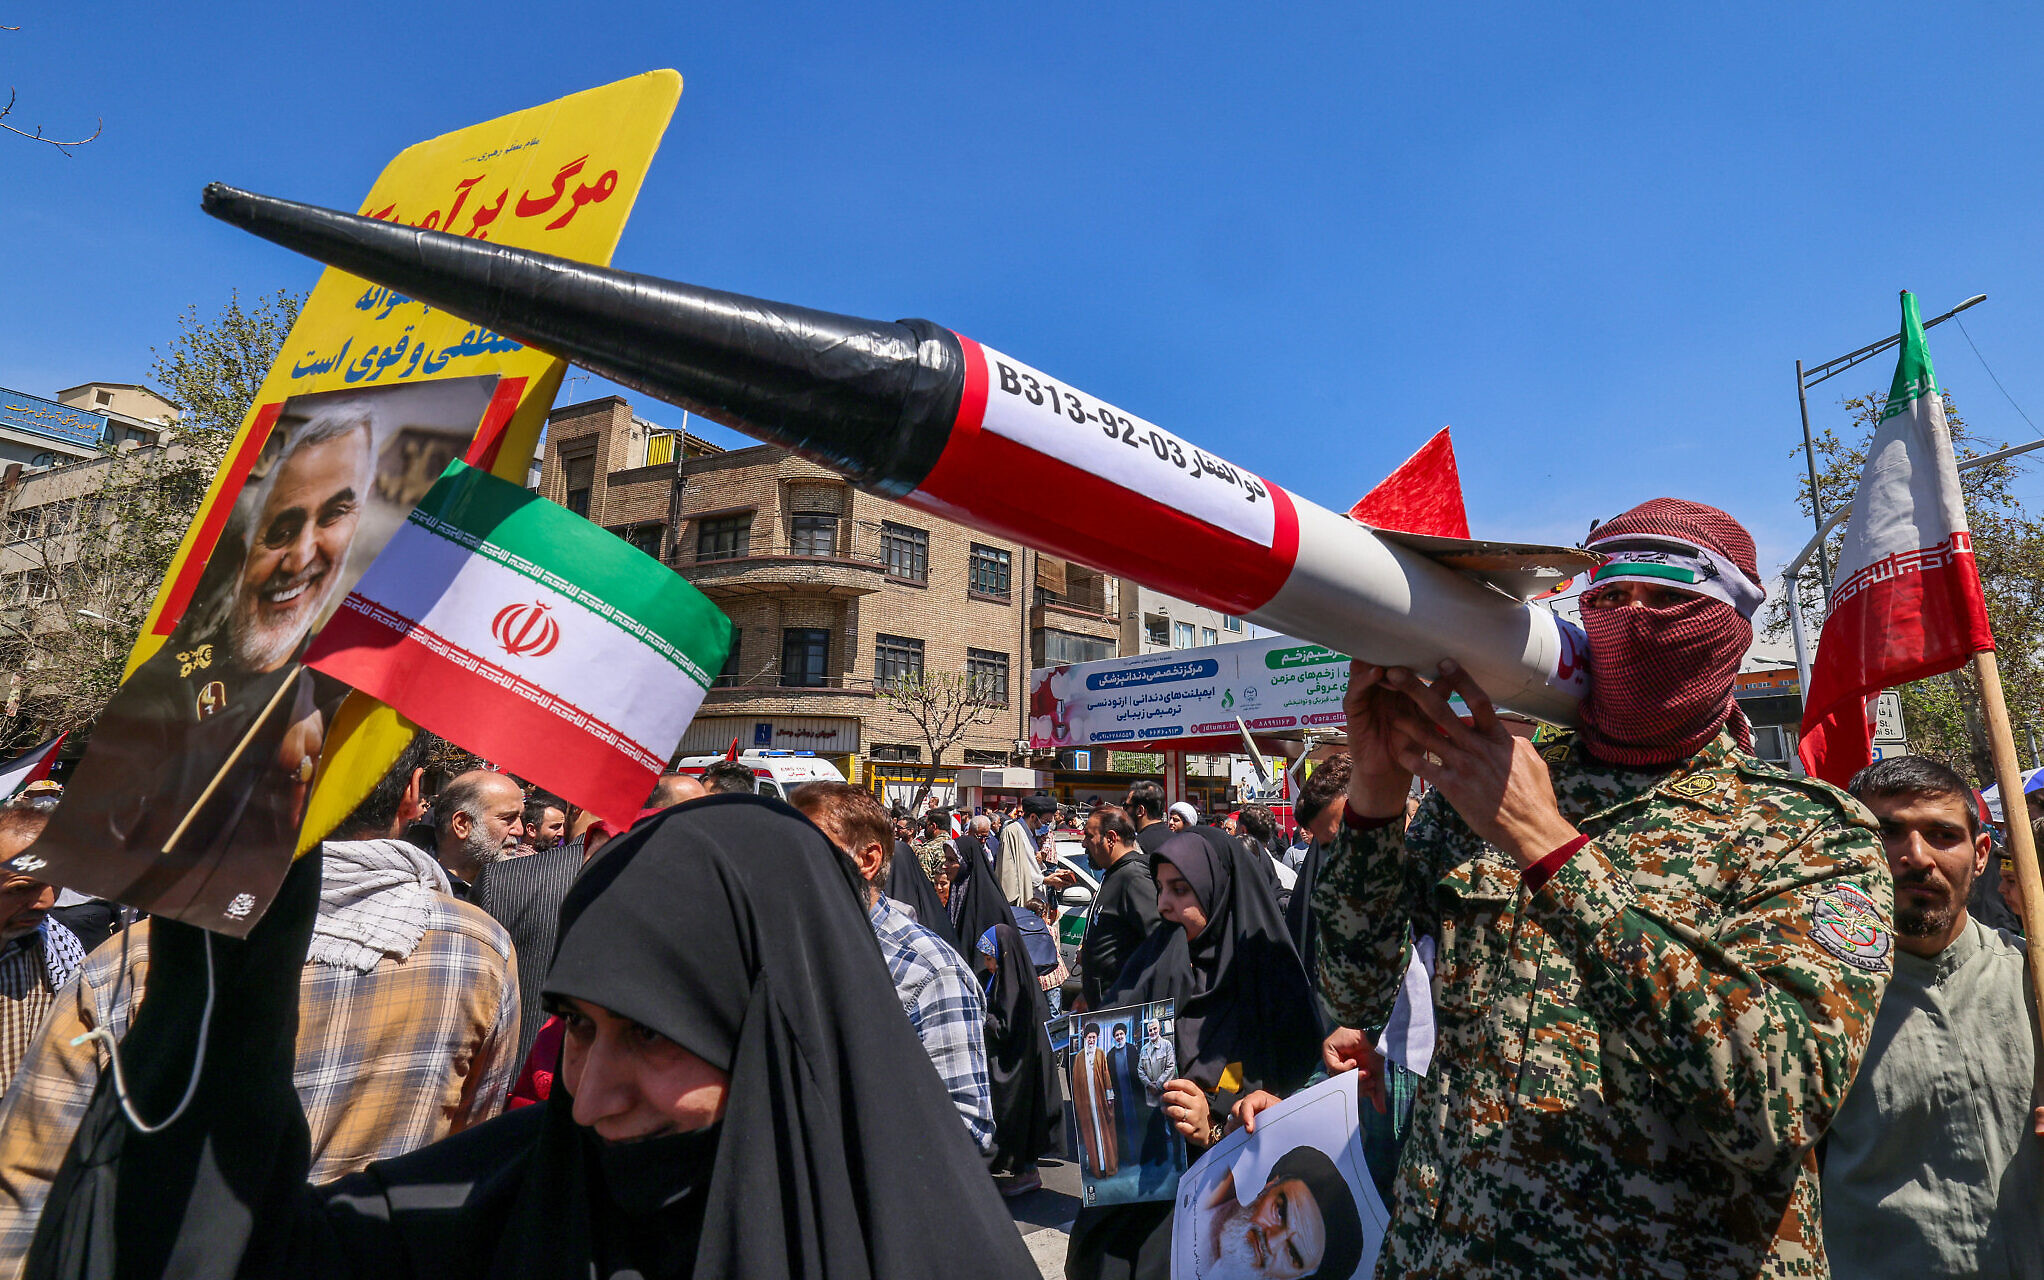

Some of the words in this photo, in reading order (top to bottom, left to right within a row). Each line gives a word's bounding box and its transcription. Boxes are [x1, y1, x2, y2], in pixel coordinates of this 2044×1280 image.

[515, 153, 619, 231] مرگ
[291, 335, 354, 380] است
[344, 325, 415, 384] قوی
[996, 360, 1187, 469] B313-92-03
[1281, 652, 1306, 666] زخم
[1146, 668, 1183, 680] تخصصی
[1182, 664, 1203, 678] مرکز
[1098, 671, 1147, 687] دندانپزشکی
[1270, 674, 1296, 686] مزمن
[1306, 682, 1338, 696] عروقی
[1087, 695, 1128, 711] ارتودنسی
[1132, 693, 1163, 706] دندانی
[1116, 708, 1147, 722] زیبایی
[1146, 705, 1182, 720] ترمیمی
[1884, 728, 1896, 736] St.
